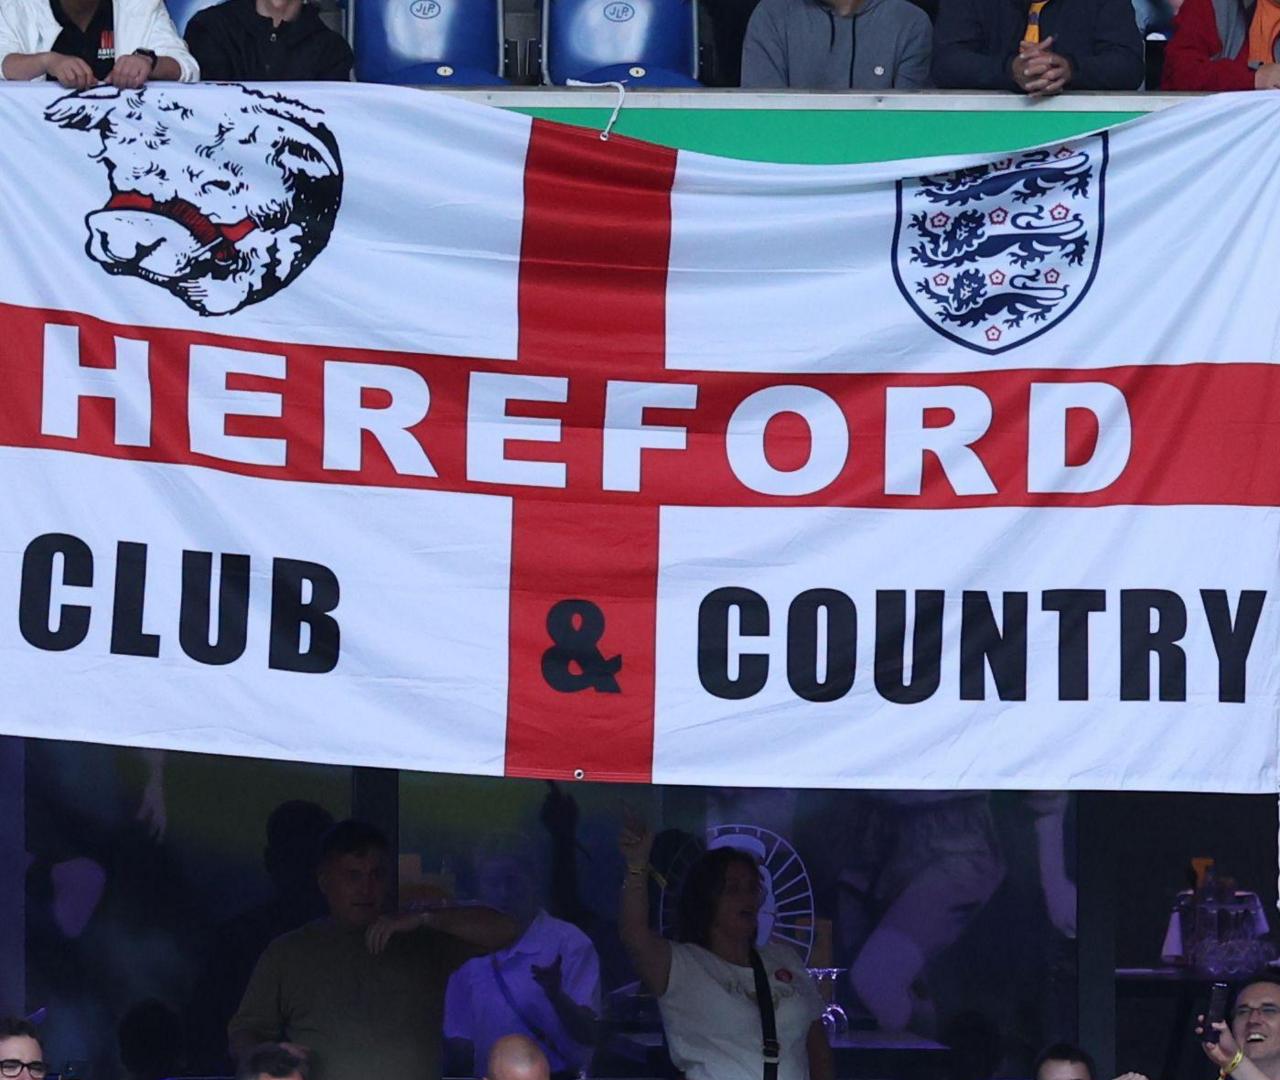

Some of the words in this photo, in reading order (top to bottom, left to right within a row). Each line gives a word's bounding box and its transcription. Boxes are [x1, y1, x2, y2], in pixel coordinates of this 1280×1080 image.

[40, 322, 1132, 499] HEREFORD
[18, 532, 342, 675] CLUB
[540, 598, 624, 695] &
[696, 586, 1267, 705] COUNTRY
